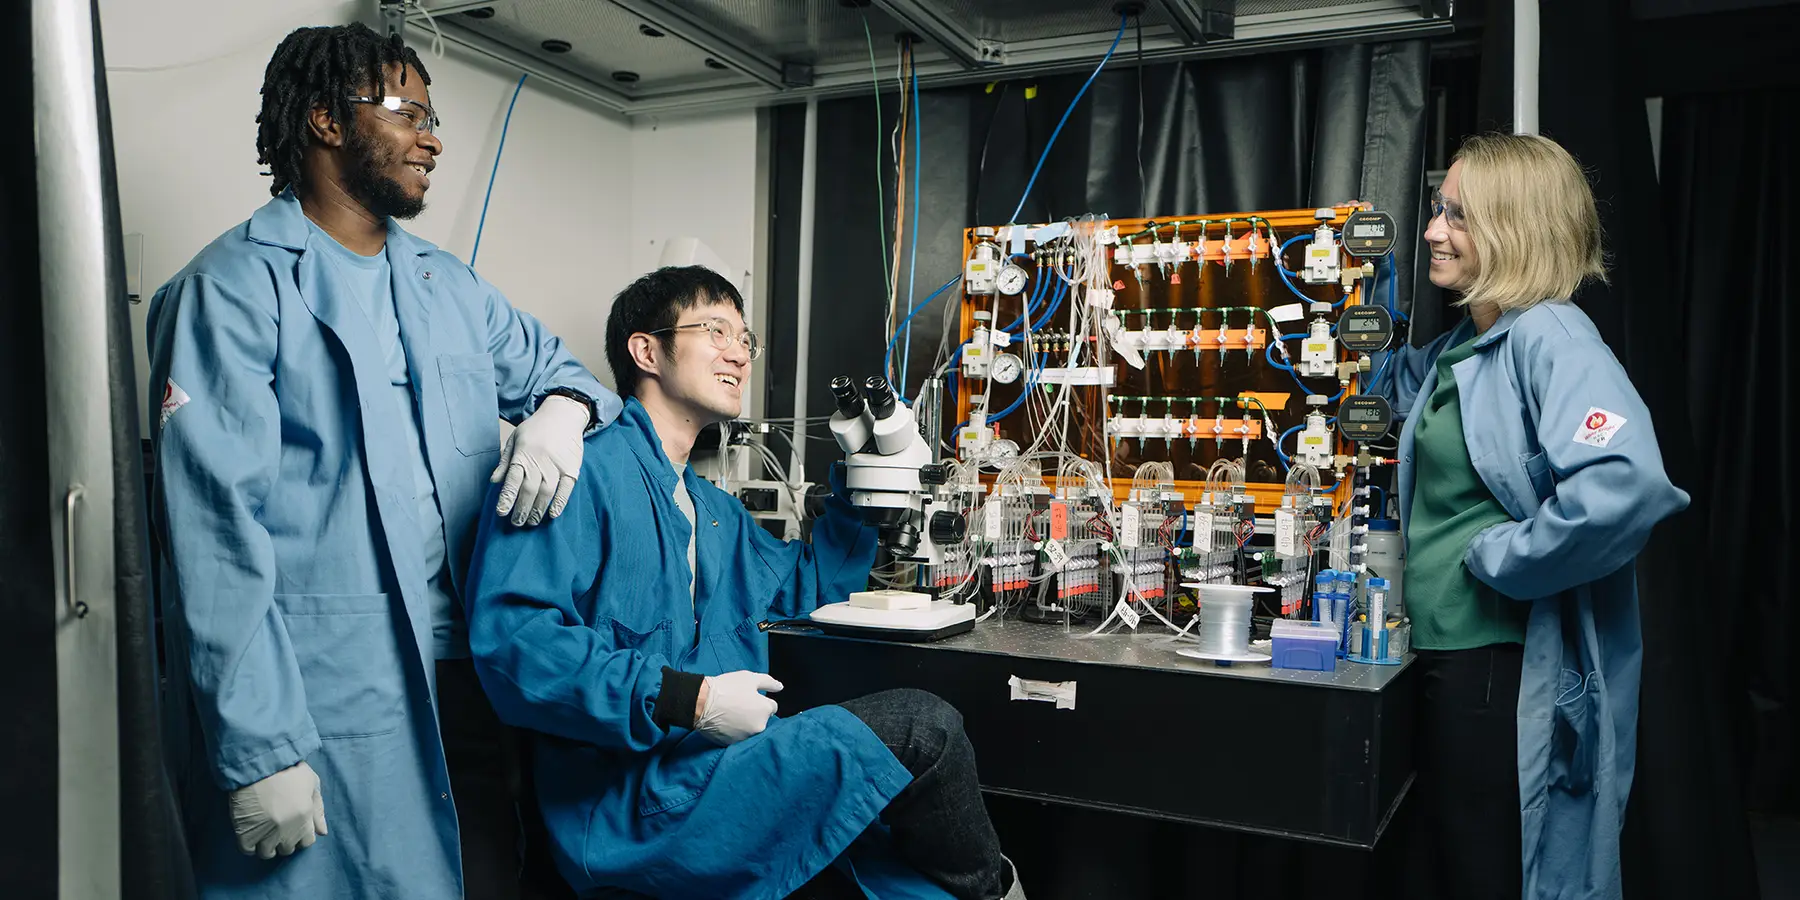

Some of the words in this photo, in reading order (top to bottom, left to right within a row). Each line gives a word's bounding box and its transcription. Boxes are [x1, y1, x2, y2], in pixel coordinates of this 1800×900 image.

[1054, 507, 1062, 533] 16-23
[1127, 514, 1136, 541] 24-31
[1199, 514, 1208, 544] 32-39
[1281, 517, 1291, 548] 40-47
[1047, 544, 1063, 564] 32-39
[1120, 608, 1137, 624] 40-47
